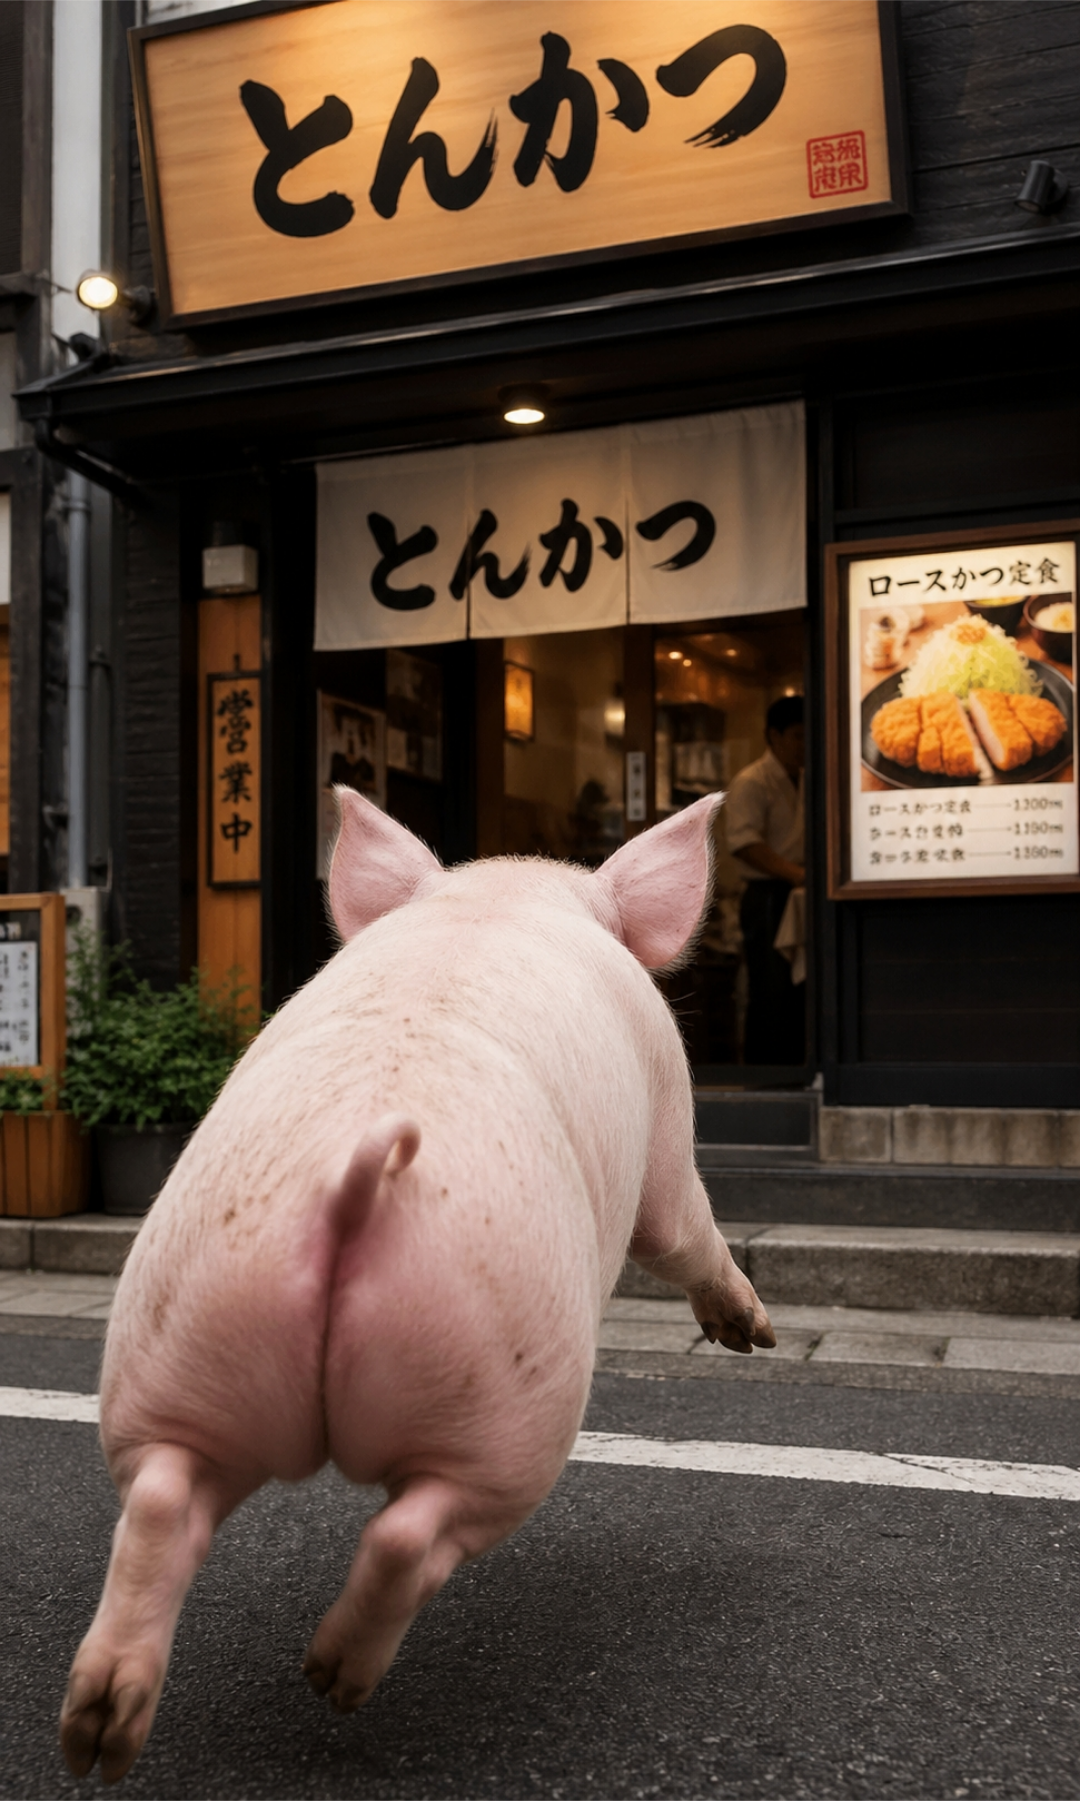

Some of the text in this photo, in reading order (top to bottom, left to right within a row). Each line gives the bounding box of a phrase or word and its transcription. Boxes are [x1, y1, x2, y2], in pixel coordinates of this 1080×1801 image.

[238, 23, 788, 239] とんかつ
[366, 497, 717, 612] とんかつ
[868, 557, 1061, 597] ロースかつ定食
